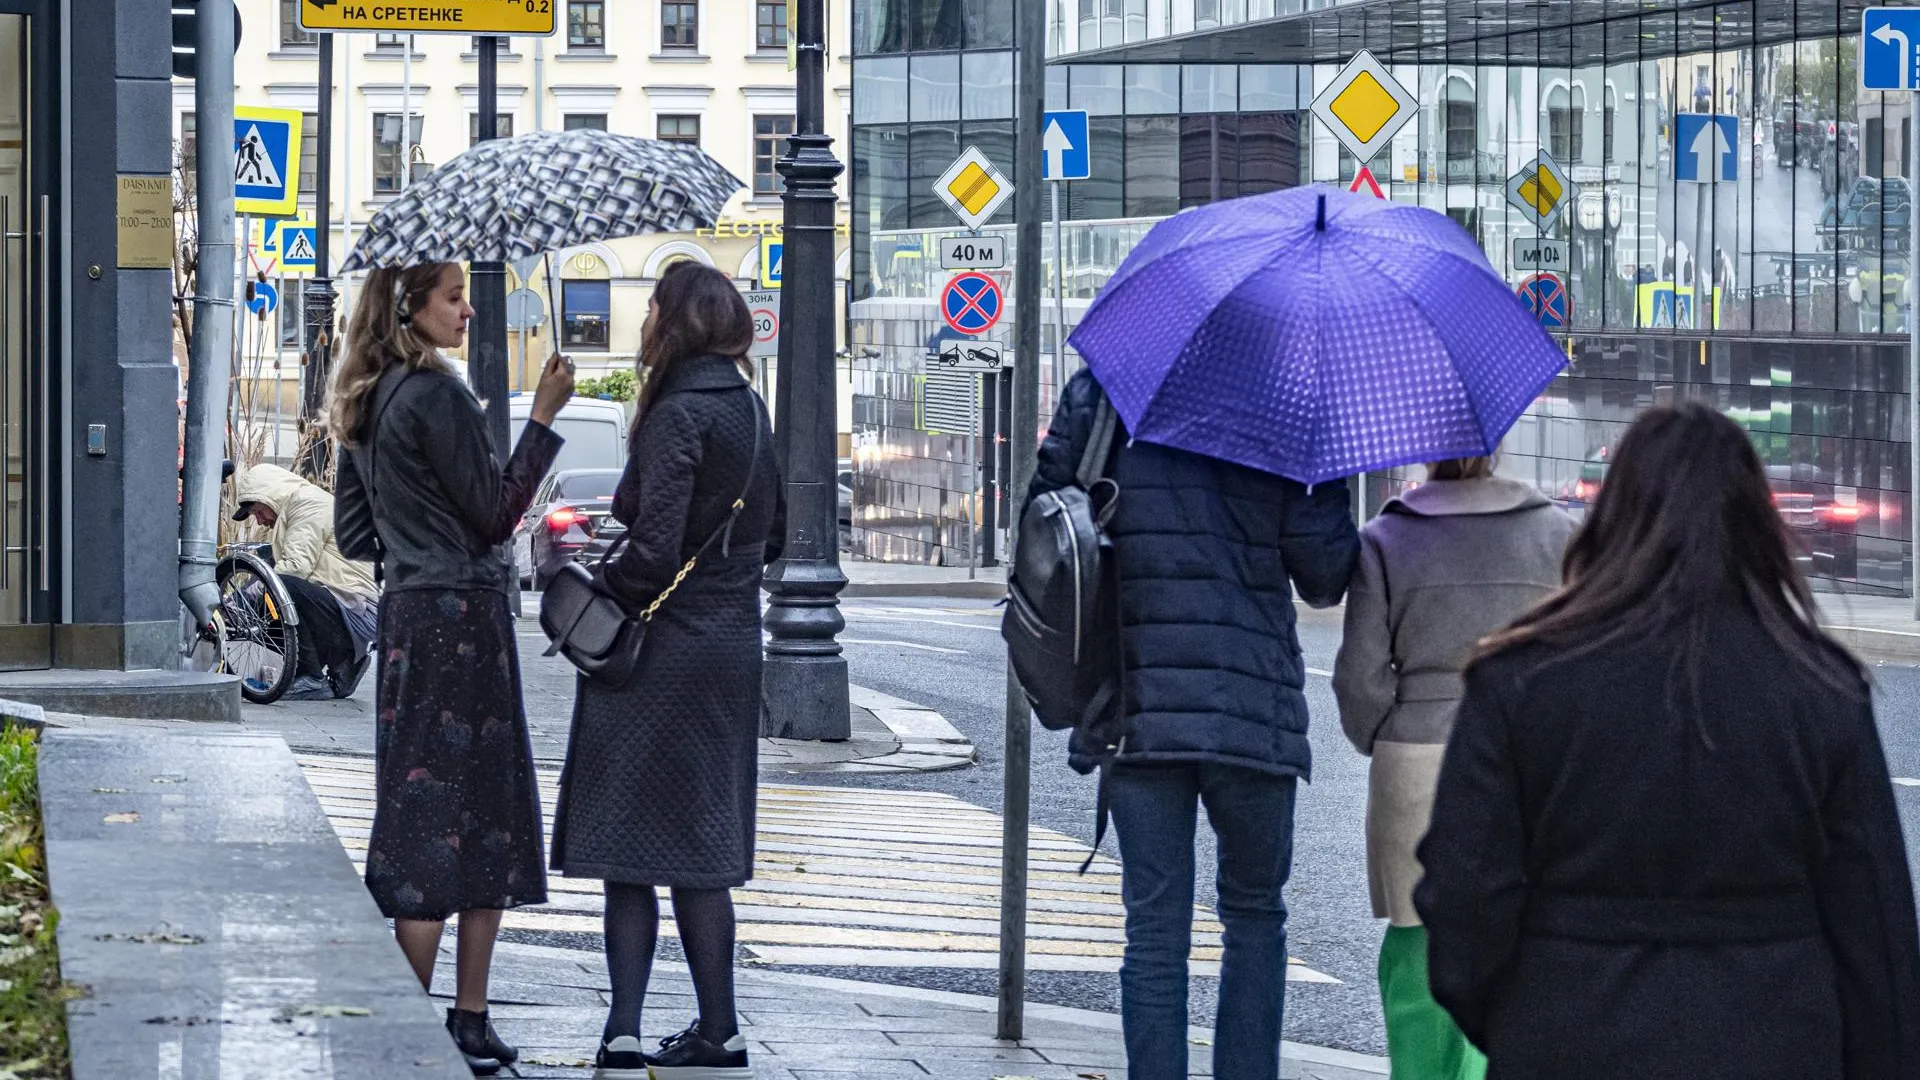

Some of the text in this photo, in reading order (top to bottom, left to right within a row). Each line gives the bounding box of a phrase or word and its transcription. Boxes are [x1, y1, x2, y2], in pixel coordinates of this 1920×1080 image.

[526, 0, 549, 13] 0.2
[343, 6, 463, 22] НА СРЕТЕНКЕ
[123, 179, 168, 190] DAISYKNIT
[951, 244, 975, 261] 40
[748, 294, 774, 304] ЗОНА
[754, 318, 771, 332] 50
